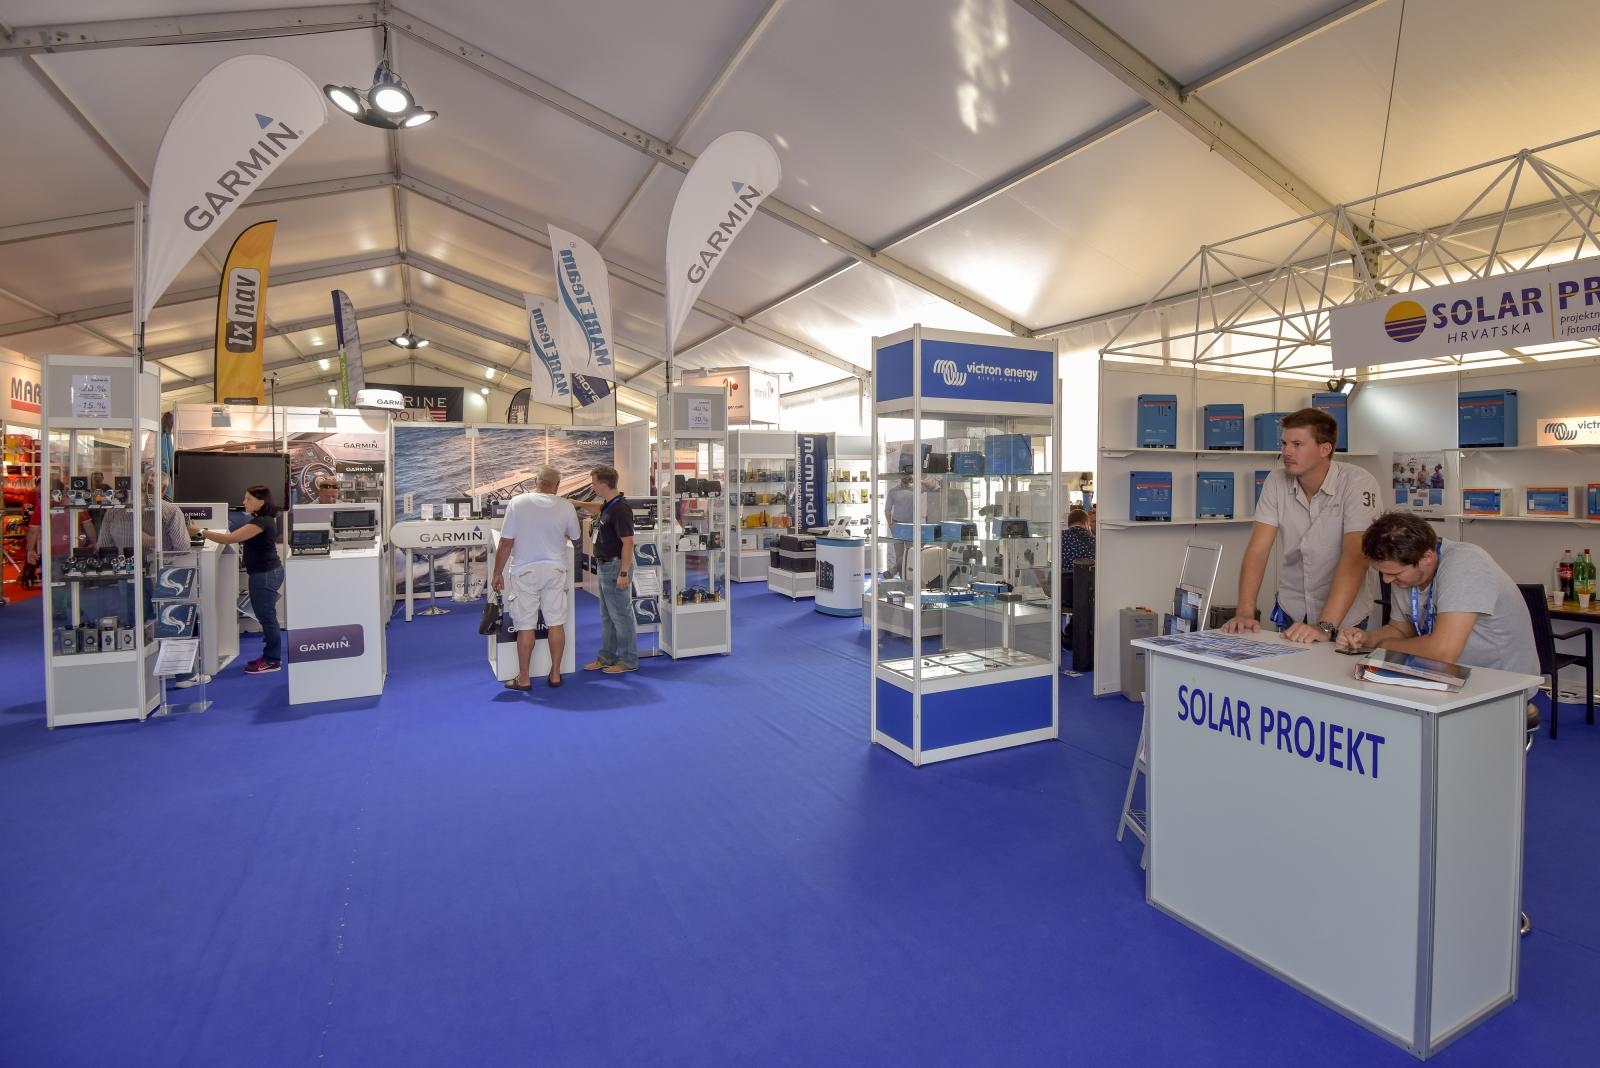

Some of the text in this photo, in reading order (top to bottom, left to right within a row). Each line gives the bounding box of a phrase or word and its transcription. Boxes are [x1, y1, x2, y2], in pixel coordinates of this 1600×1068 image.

[183, 121, 300, 232] GARMIN
[687, 184, 762, 284] GARMIN
[1432, 287, 1544, 329] SOLAR
[1447, 322, 1531, 344] HRVATSKA
[966, 361, 1038, 382] victron energy
[804, 437, 817, 526] mcmurdo
[419, 531, 484, 543] GARMIN
[507, 623, 549, 633] GIN
[299, 640, 350, 652] GARMIN
[1177, 684, 1386, 779] SOLAR PROJEKT
